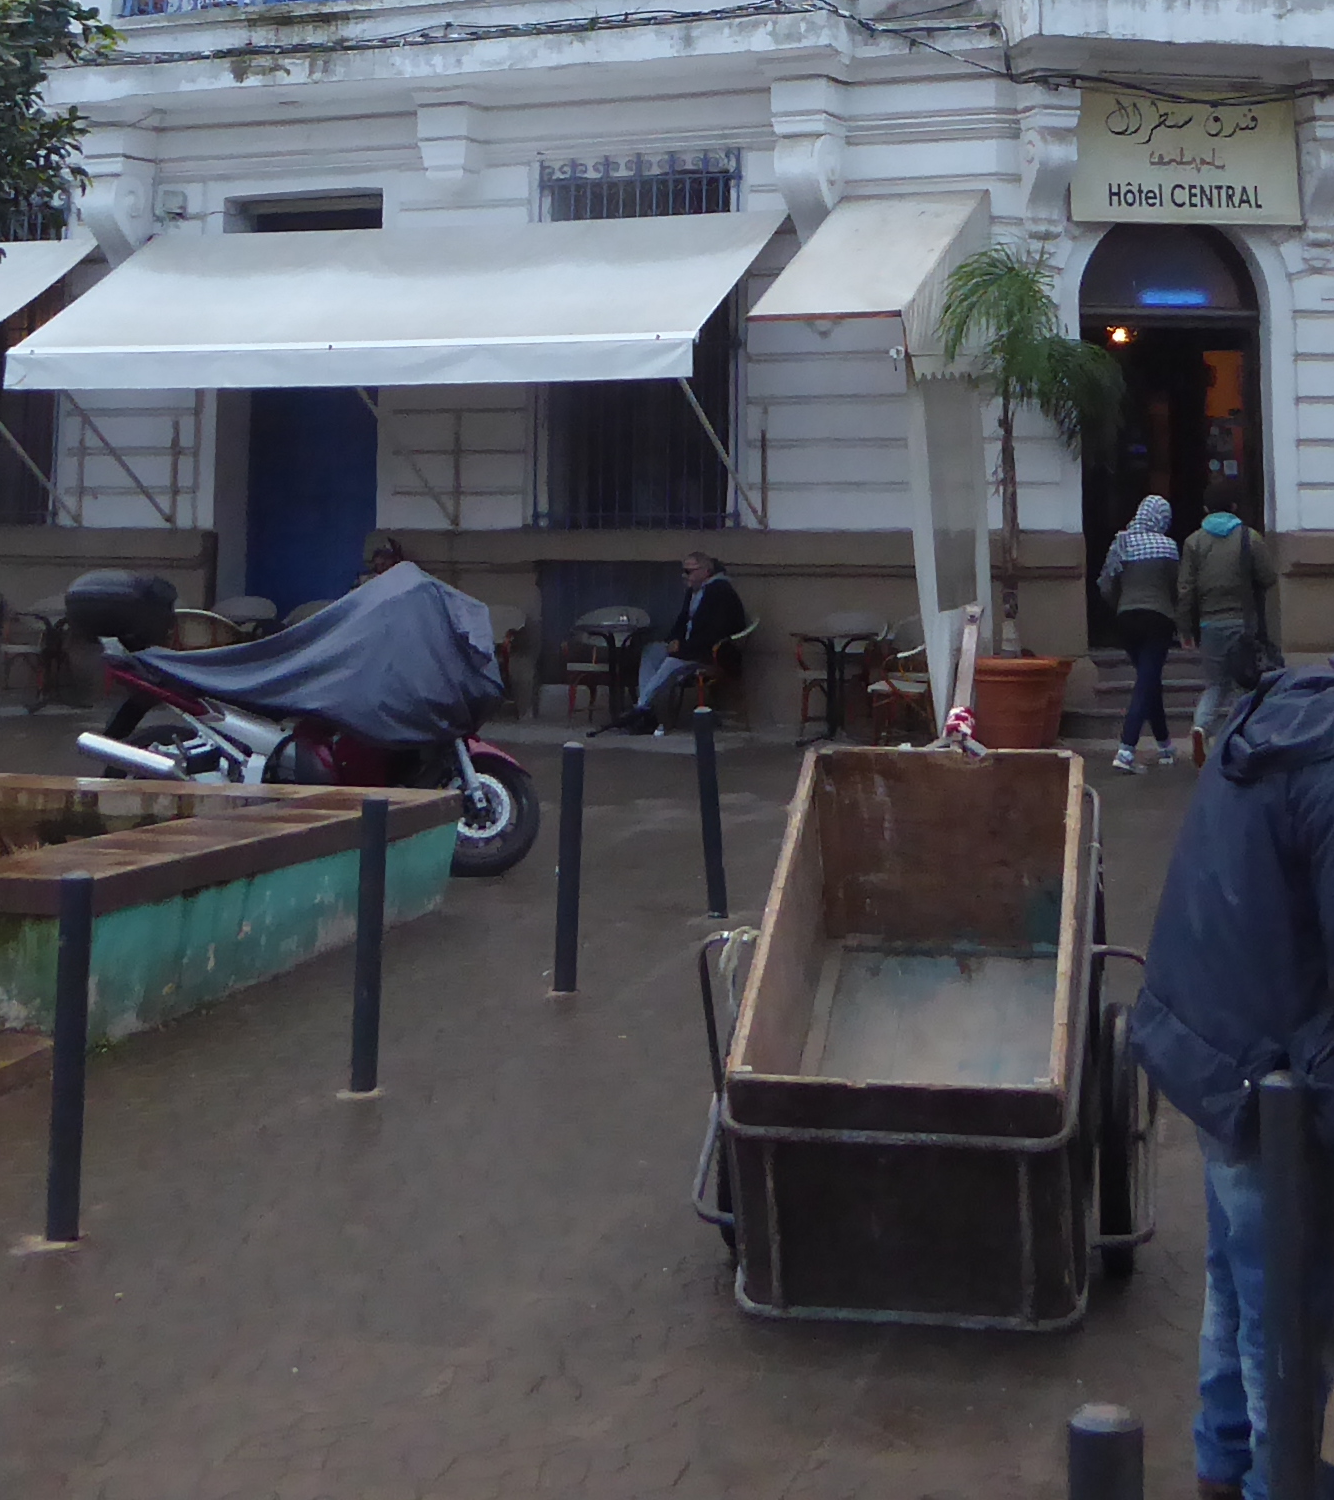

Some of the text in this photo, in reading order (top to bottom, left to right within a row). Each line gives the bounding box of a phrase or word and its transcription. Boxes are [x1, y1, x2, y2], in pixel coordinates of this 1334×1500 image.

[1204, 108, 1259, 137] فندق
[1108, 181, 1263, 210] Hôtel CENTRAL
